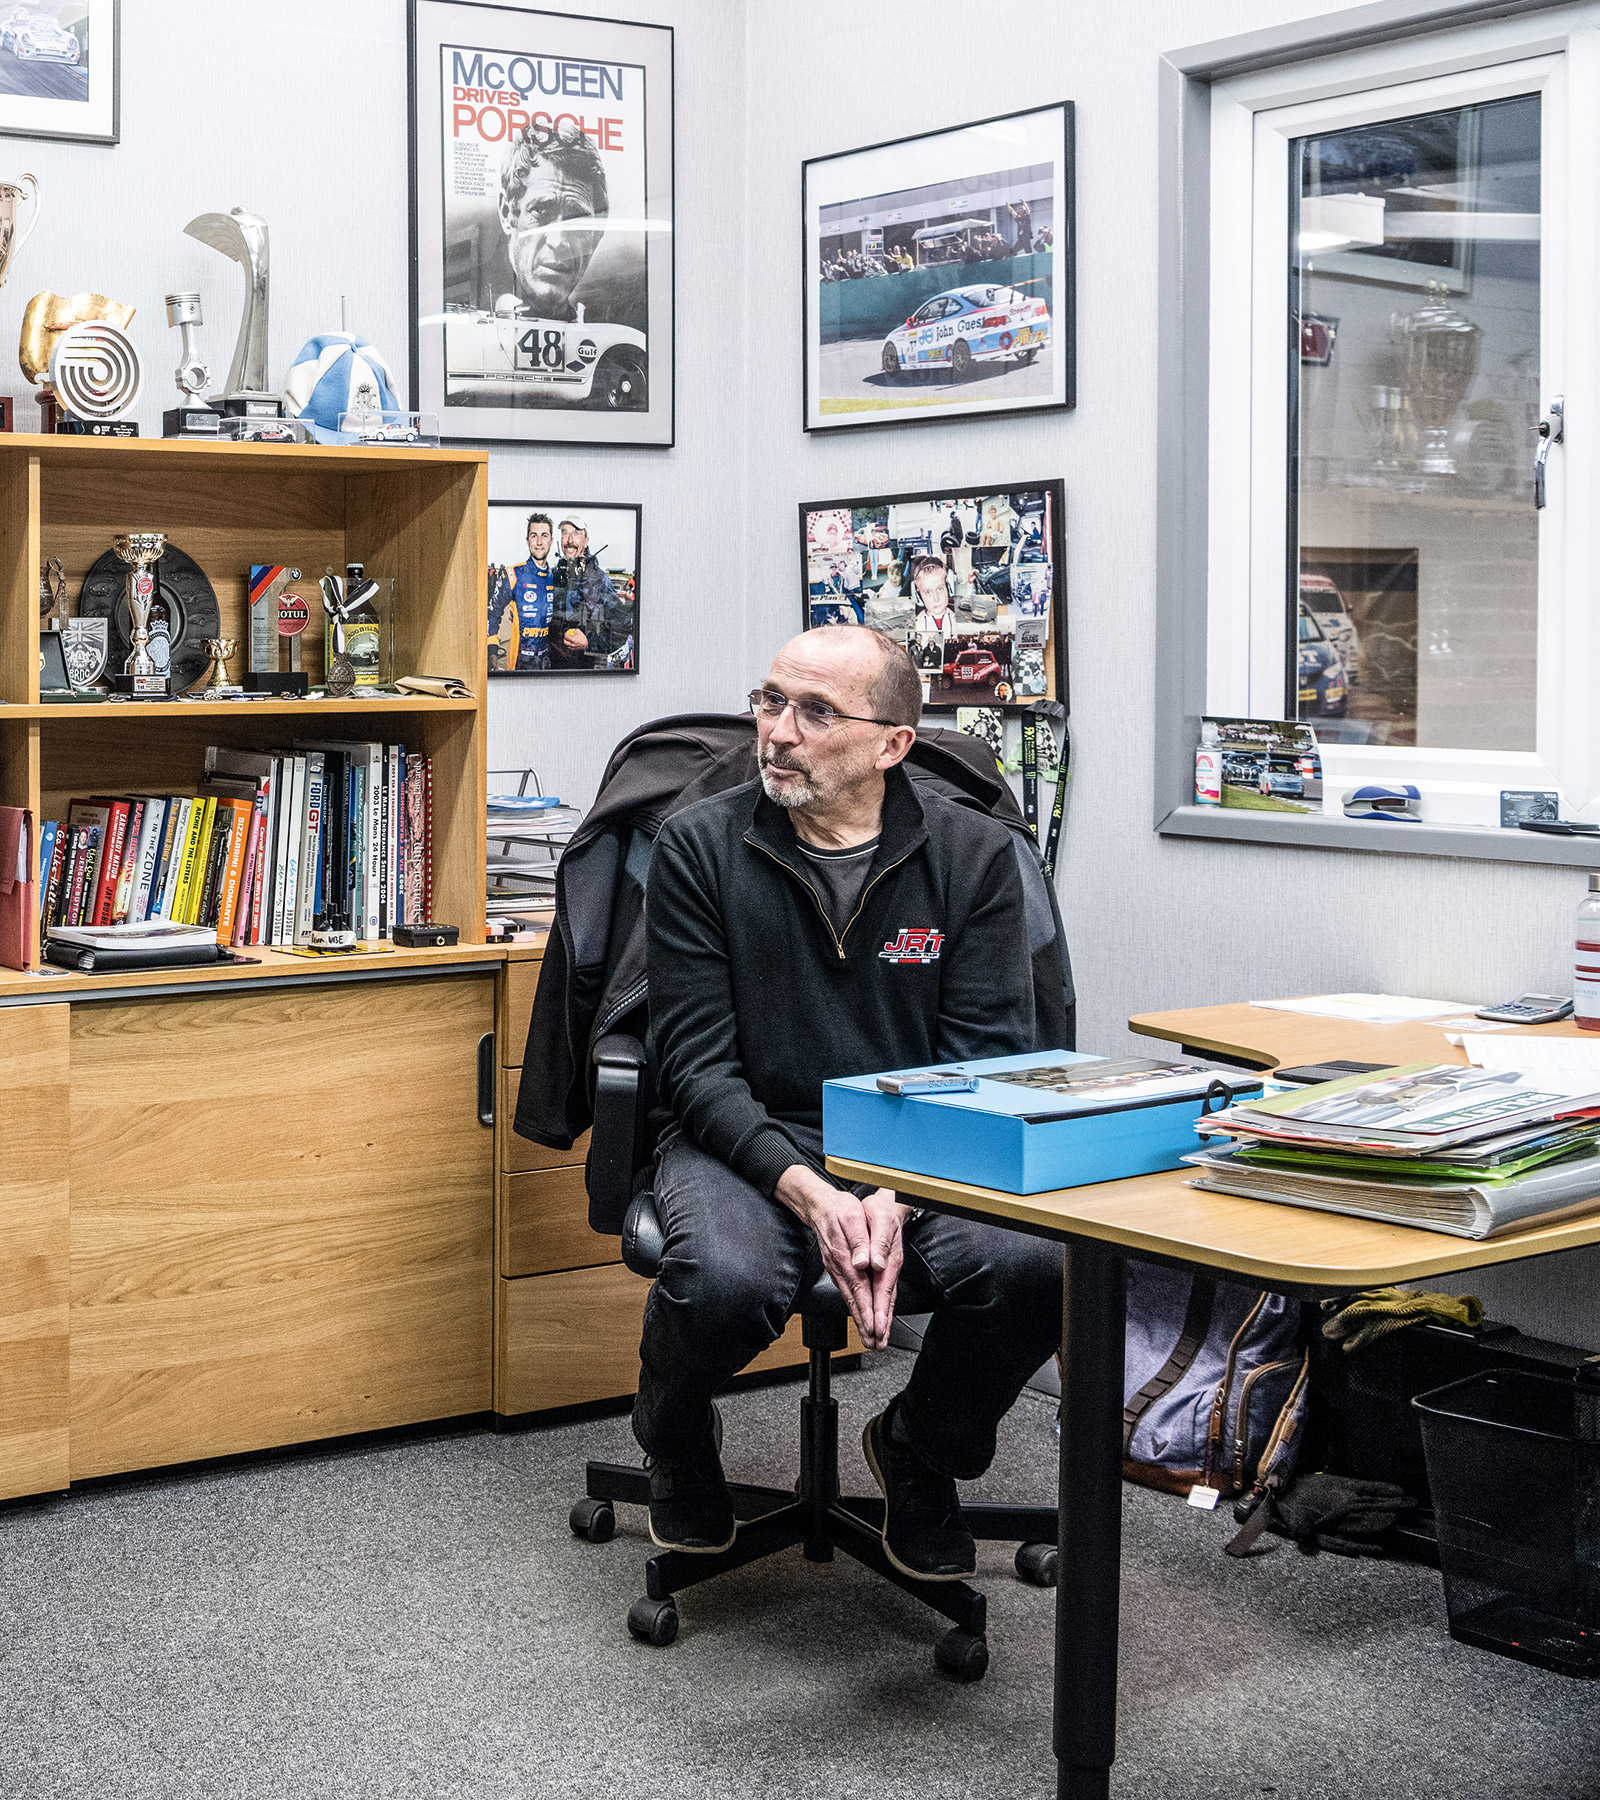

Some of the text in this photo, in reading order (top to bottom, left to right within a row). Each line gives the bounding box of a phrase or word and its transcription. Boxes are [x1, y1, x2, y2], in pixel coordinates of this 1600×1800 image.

[453, 86, 521, 107] DRIVES
[453, 103, 624, 151] PORSCHE
[936, 316, 986, 341] John Guest
[1013, 328, 1048, 348] PIRTEK
[517, 329, 563, 368] 48
[578, 347, 597, 356] Gulf
[485, 374, 552, 382] PORSCHE
[249, 403, 278, 415] AUTOSPORT
[522, 627, 549, 637] PIRTE
[70, 669, 90, 681] BRDC
[962, 668, 972, 676] 555
[411, 761, 422, 796] Edwards
[193, 806, 202, 831] ARCHIE
[308, 782, 321, 833] FORD GT
[373, 807, 379, 817] Le
[152, 823, 158, 832] IN
[161, 803, 180, 861] The Reynard Story
[190, 831, 198, 845] AND
[110, 813, 127, 879] EARNHARDT NATION
[124, 803, 144, 884] RAPID RESPONSE
[148, 836, 157, 850] THE
[209, 835, 218, 862] Those
[231, 816, 245, 870] BIZZARRINI
[372, 842, 378, 852] 24
[48, 830, 65, 903] Go Like Hell
[86, 848, 96, 880] Flat Out
[140, 851, 155, 890] ZONE
[183, 859, 192, 884] LISTERS
[205, 863, 213, 884] were
[256, 851, 264, 878] Smith's
[67, 875, 73, 883] by
[71, 855, 85, 925] JENSON BUTTON
[254, 879, 262, 902] DRIVE
[409, 841, 424, 919] Sponsorship
[104, 886, 113, 901] JAY
[222, 878, 236, 927] DIOMANTE
[199, 901, 208, 923] days
[274, 911, 282, 937] PORSCHE
[285, 909, 294, 936] PORSCHE
[884, 933, 945, 952] JRT
[1434, 1093, 1555, 1125] BULLETIN
